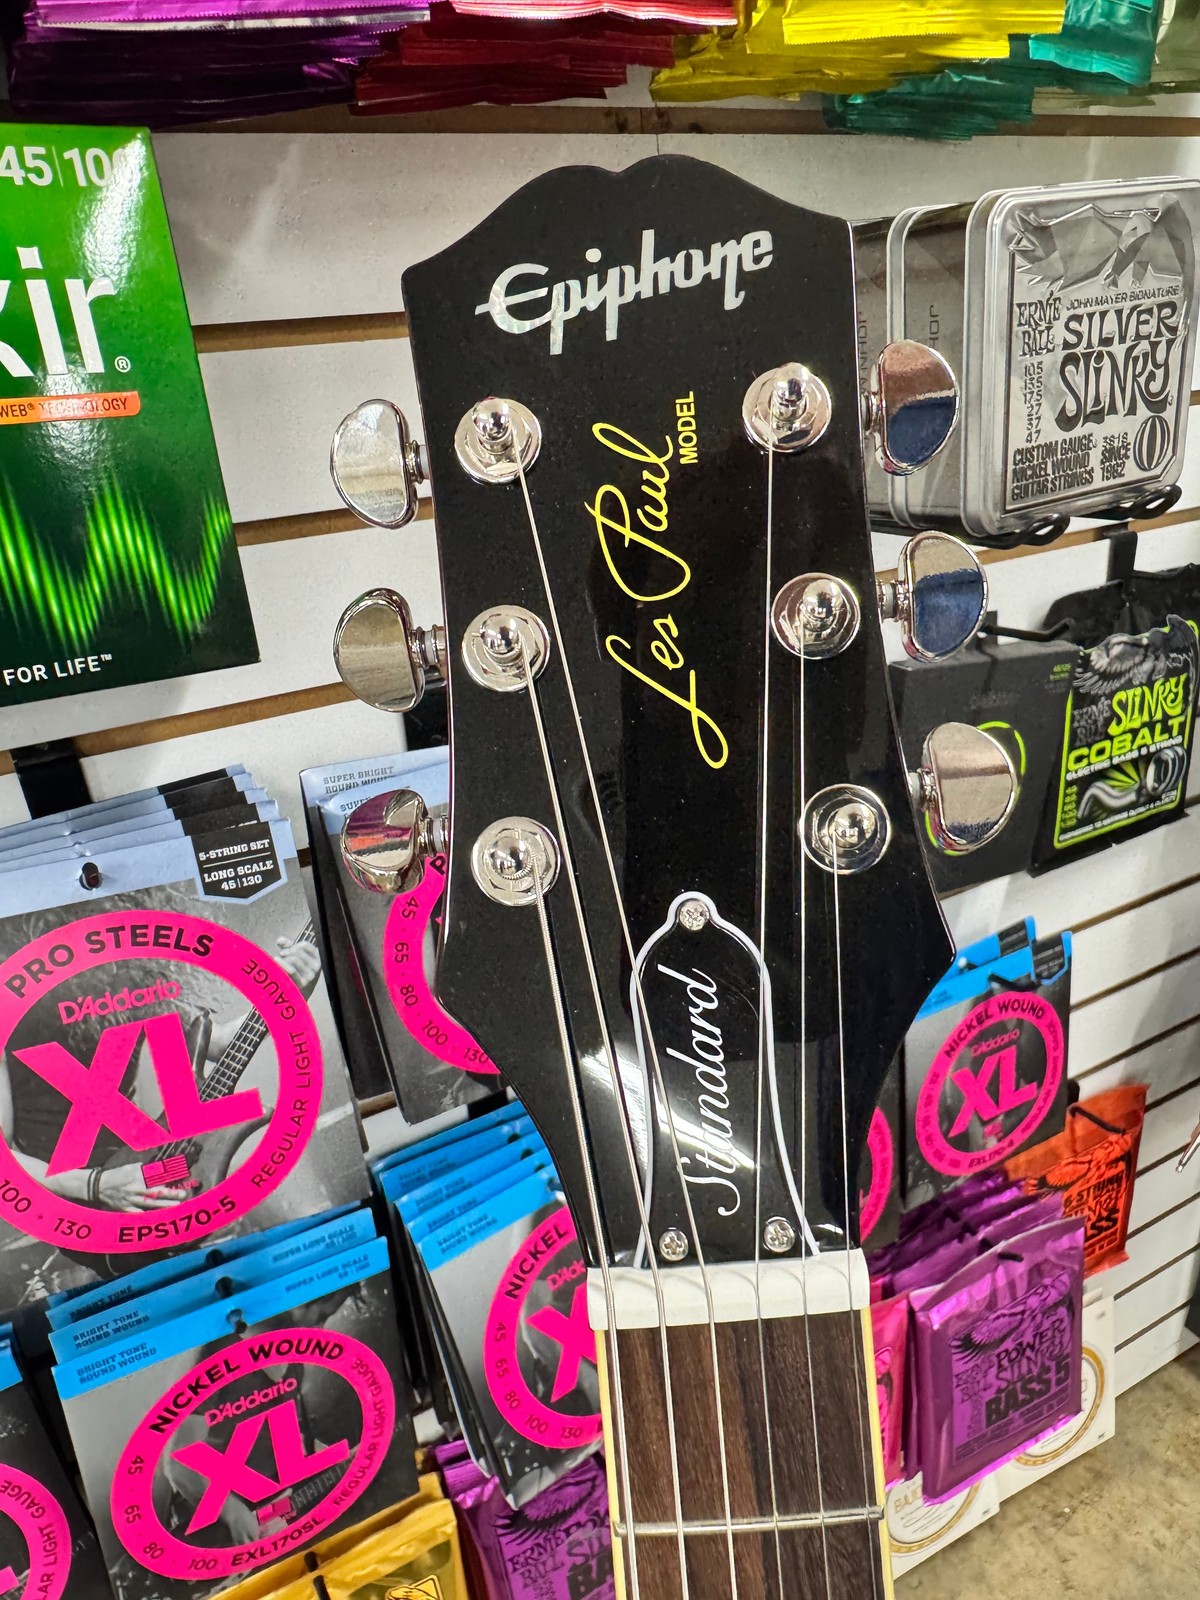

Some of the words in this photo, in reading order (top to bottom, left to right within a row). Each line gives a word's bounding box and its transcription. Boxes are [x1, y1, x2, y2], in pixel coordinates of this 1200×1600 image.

[475, 229, 773, 355] Epiphone
[1015, 290, 1062, 328] ERNIE
[1066, 298, 1093, 311] JOHN
[1094, 293, 1128, 307] MAYER
[1061, 300, 1179, 351] SILVER
[676, 391, 698, 465] MODEL
[1013, 440, 1058, 466] CUSTOM
[1060, 432, 1093, 457] GAUGE
[1011, 477, 1049, 501] GUITAR
[1050, 467, 1094, 492] STRINGS
[1012, 460, 1050, 484] NICKEL
[1051, 452, 1090, 475] WOUND
[584, 422, 691, 602] Paul
[3, 664, 48, 686] FOR
[605, 613, 729, 770] Les
[1107, 673, 1188, 736] SLINKY
[1068, 716, 1185, 771] COBALT
[324, 772, 356, 784] SUPER
[358, 766, 394, 778] BRIGHT
[199, 843, 249, 861] 5-STRING
[250, 839, 270, 851] SET
[203, 868, 235, 883] LONG
[237, 860, 274, 876] SCALE
[401, 895, 416, 920] 45
[4, 942, 75, 999] PRO
[85, 924, 214, 957] STEELS
[394, 941, 409, 964] 65
[241, 958, 296, 1021] GAUGE
[400, 983, 418, 1007] 80
[422, 1020, 448, 1045] 100
[944, 1008, 993, 1058] NICKEL
[997, 999, 1045, 1020] WOUND
[290, 1031, 311, 1089] LIGHT
[12, 1012, 264, 1178] XL
[657, 964, 741, 1216] Standard
[948, 1045, 1038, 1138] XL
[251, 1098, 309, 1189] REGULAR
[53, 1217, 92, 1240] 130
[118, 1194, 237, 1243] EPS170-5
[505, 1225, 569, 1299] NICKEL
[112, 1310, 140, 1326] TONE
[494, 1322, 507, 1342] 45
[118, 1342, 148, 1358] TONE
[118, 1347, 157, 1369] WOUND
[996, 1318, 1065, 1371] POWER
[149, 1358, 240, 1434] NICKEL
[248, 1338, 344, 1363] WOUND
[495, 1358, 510, 1379] 65
[504, 1390, 521, 1410] 80
[525, 1413, 548, 1434] 100
[561, 1426, 582, 1439] 130
[127, 1455, 145, 1476] 45
[169, 1399, 350, 1536] XL
[333, 1442, 379, 1507] REGULAR
[372, 1400, 385, 1438] LIGHT
[0, 1479, 46, 1519] GAUGE
[124, 1504, 141, 1524] 65
[38, 1525, 57, 1566] LIGHT
[143, 1541, 165, 1560] 80
[231, 1516, 326, 1567] EXL170SL
[188, 1558, 218, 1571] 100
